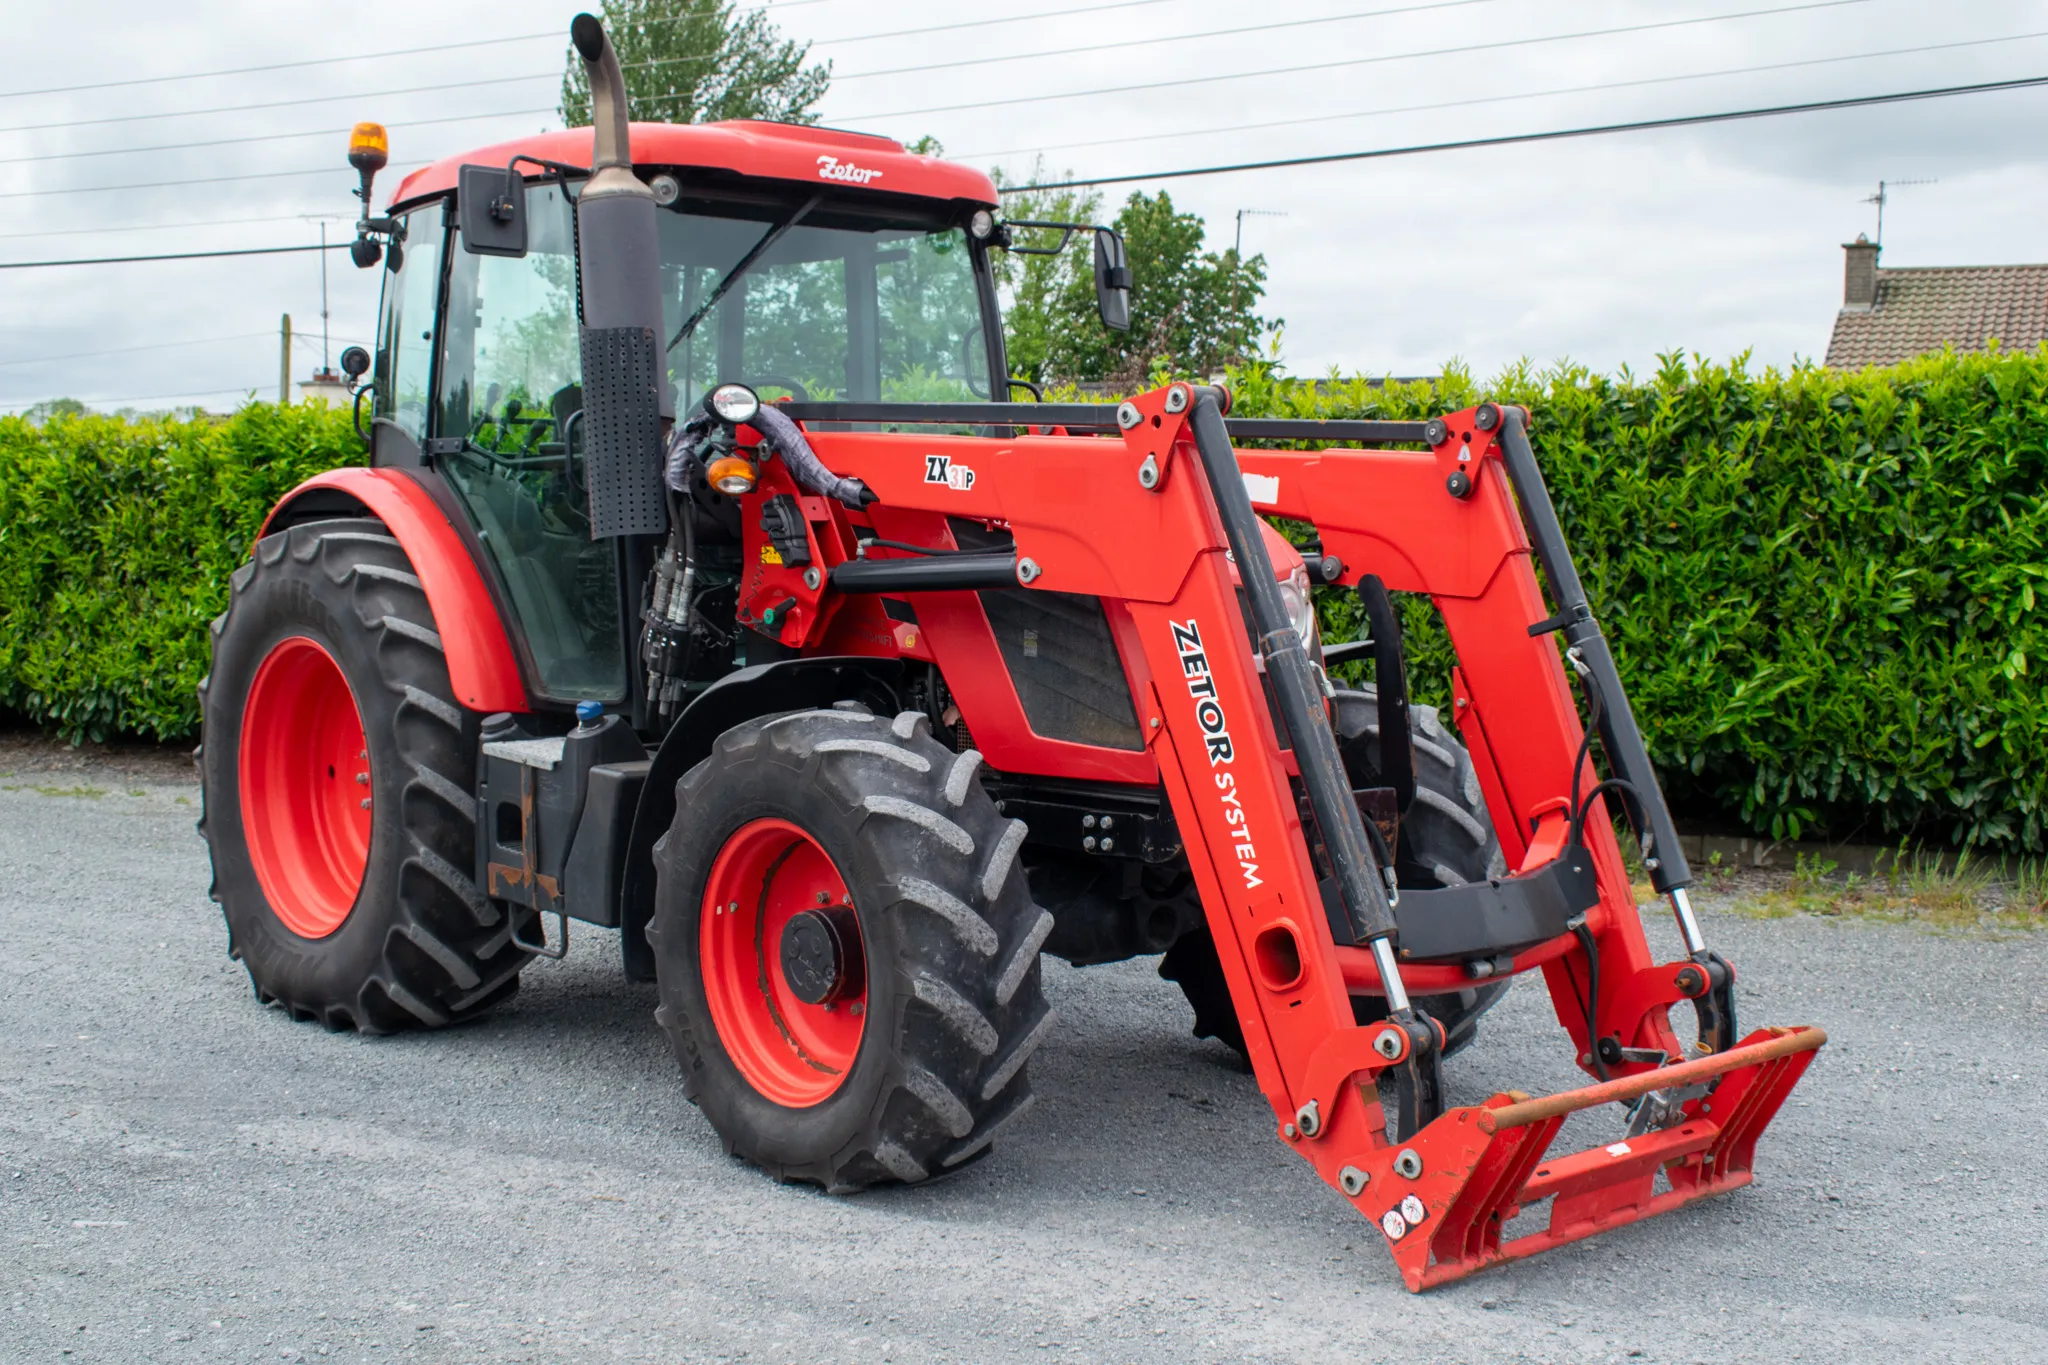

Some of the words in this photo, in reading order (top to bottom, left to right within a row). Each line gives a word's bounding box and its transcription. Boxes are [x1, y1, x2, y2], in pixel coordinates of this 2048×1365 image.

[816, 155, 883, 184] Zetor
[1169, 619, 1235, 767] ZETOR
[1214, 772, 1264, 889] SYSTEM
